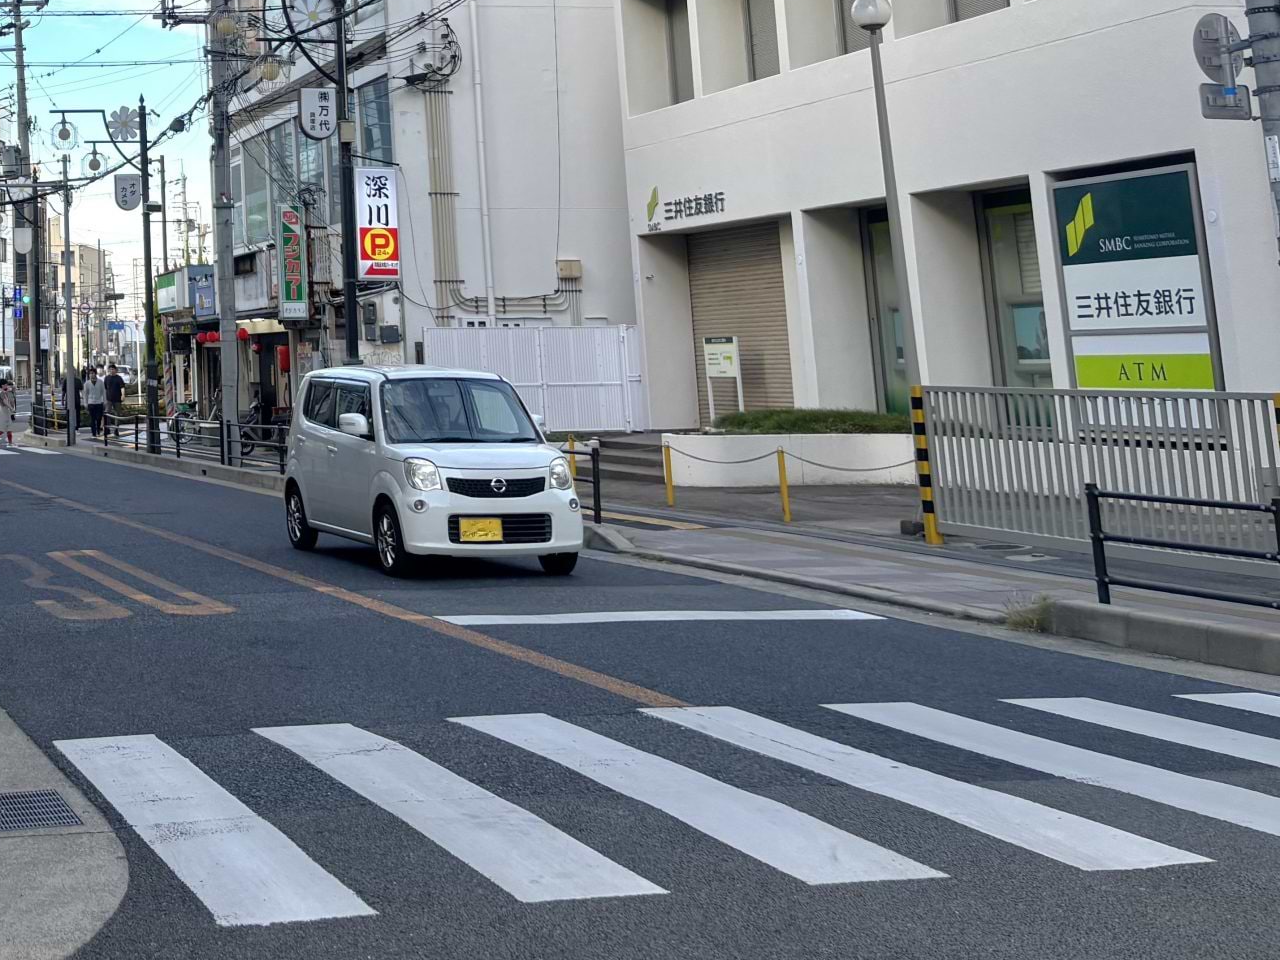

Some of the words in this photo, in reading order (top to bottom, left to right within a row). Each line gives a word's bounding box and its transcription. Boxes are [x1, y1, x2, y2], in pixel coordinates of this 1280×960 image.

[365, 175, 389, 227] 深川
[663, 191, 725, 221] 三井住友銀行
[370, 233, 390, 256] P
[1099, 236, 1132, 253] SMBC
[283, 232, 301, 301] フジカラー
[1075, 288, 1196, 319] 三井住友銀行
[1118, 362, 1168, 382] ATM
